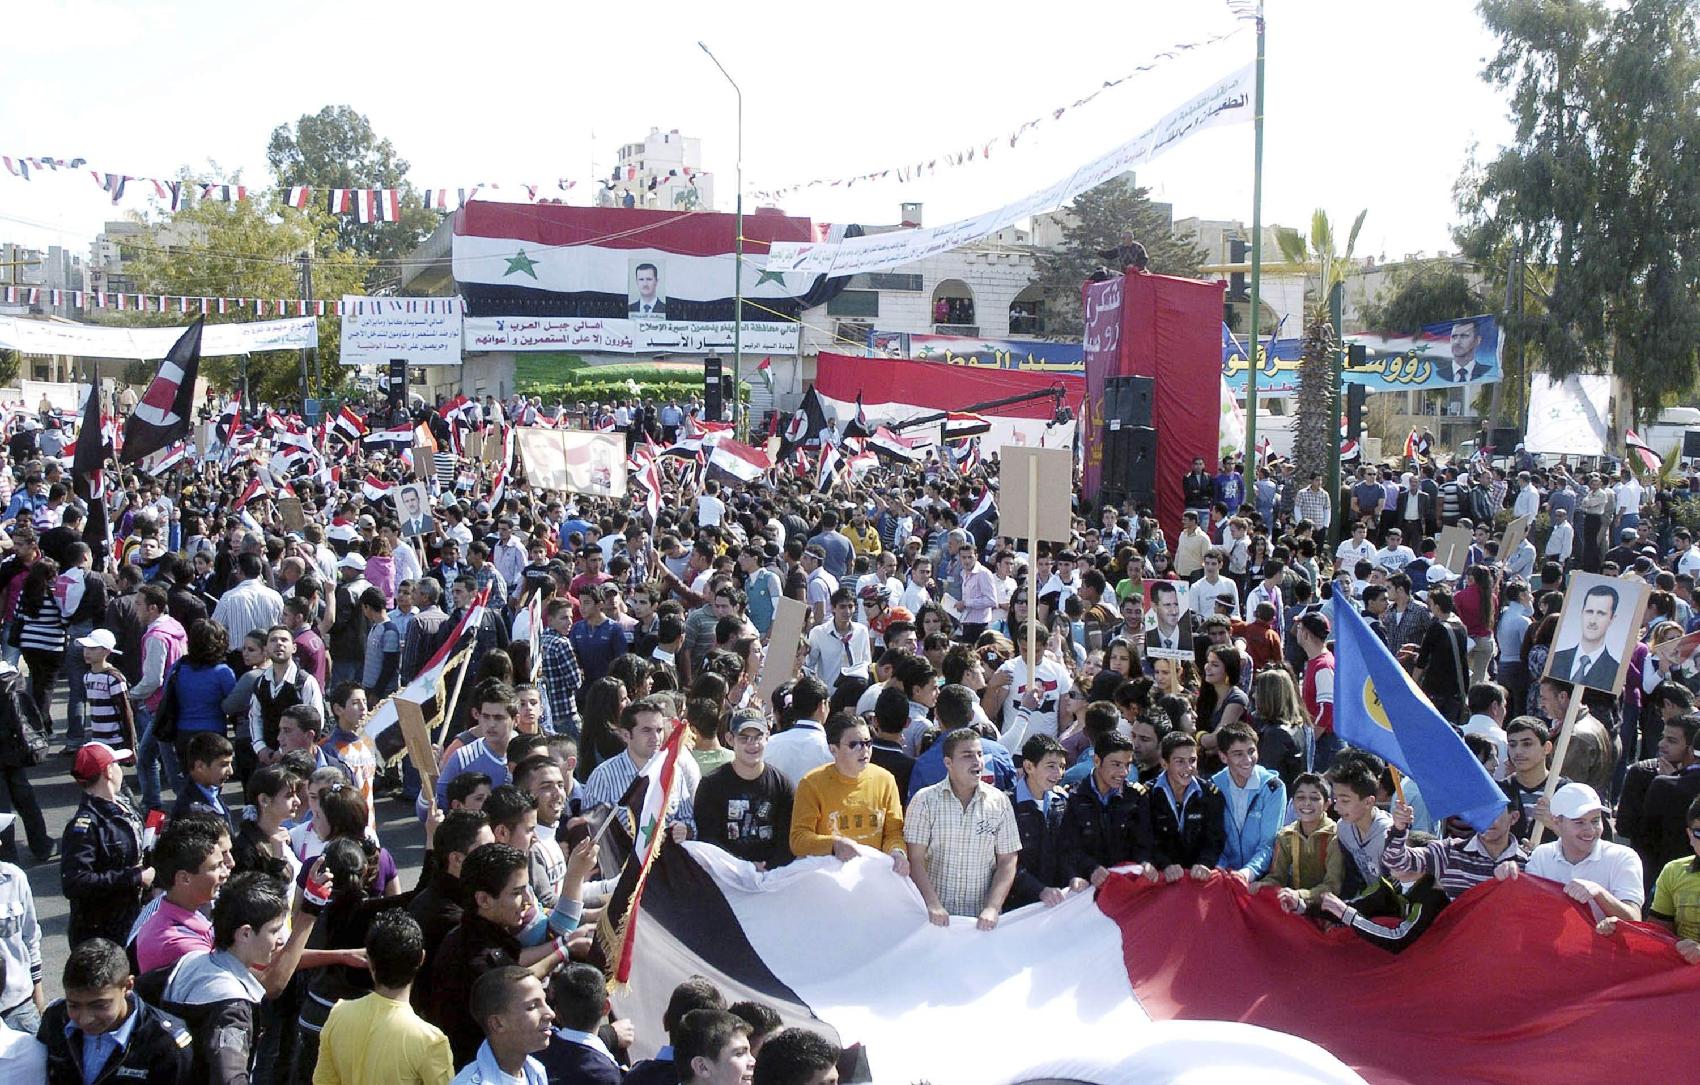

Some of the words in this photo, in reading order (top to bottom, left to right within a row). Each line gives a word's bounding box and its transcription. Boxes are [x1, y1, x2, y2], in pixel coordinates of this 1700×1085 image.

[1086, 282, 1121, 328] شكرا
[495, 320, 505, 331] لا
[510, 320, 540, 332] العرب
[543, 320, 570, 333] جبل
[520, 333, 570, 346] المستعمرين
[571, 334, 590, 345] على
[604, 335, 633, 349] يثورون
[1083, 322, 1120, 361] روسيا
